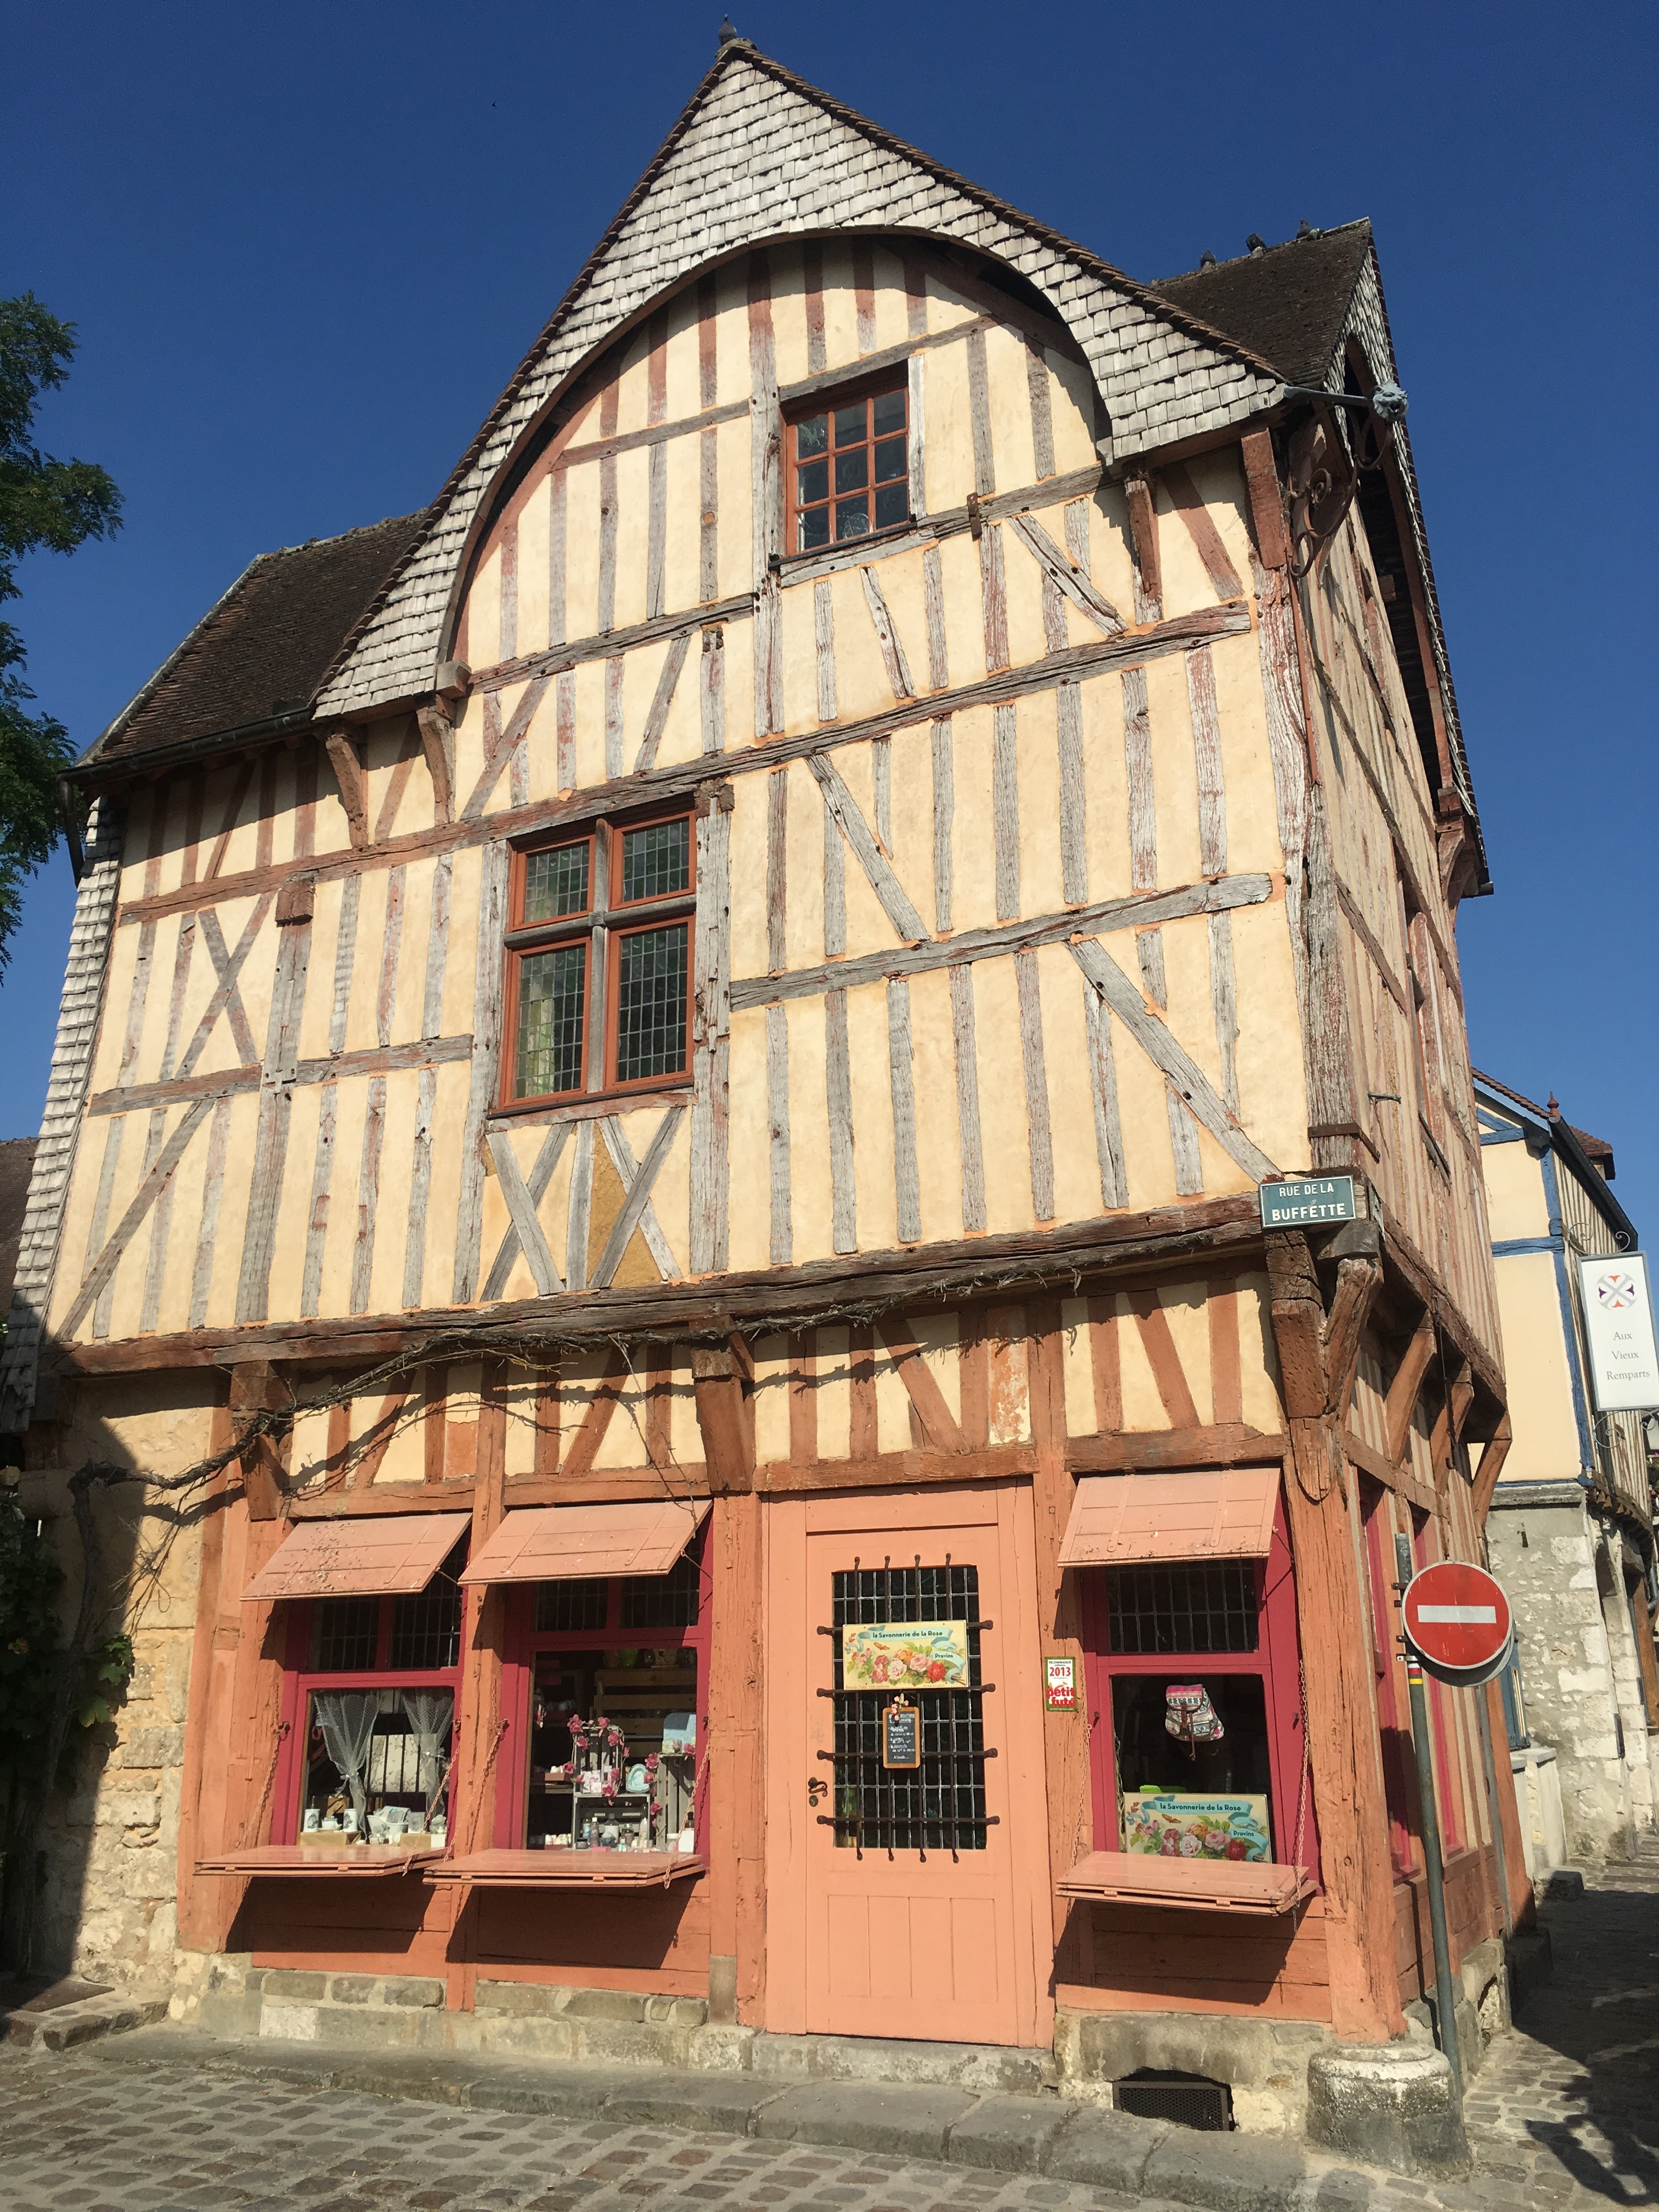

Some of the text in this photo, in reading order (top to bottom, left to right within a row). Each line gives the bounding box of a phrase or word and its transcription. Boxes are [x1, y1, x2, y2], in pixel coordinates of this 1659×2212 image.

[1279, 1182, 1334, 1198] RUE DE LA
[1272, 1203, 1346, 1221] BUFFETTE
[1613, 1331, 1633, 1341] Aux
[1611, 1351, 1640, 1360] Vieux
[1606, 1371, 1650, 1381] Remparts
[1049, 1667, 1070, 1677] 2013
[1047, 1687, 1075, 1699] petit
[1167, 1803, 1205, 1811] Savonnerie
